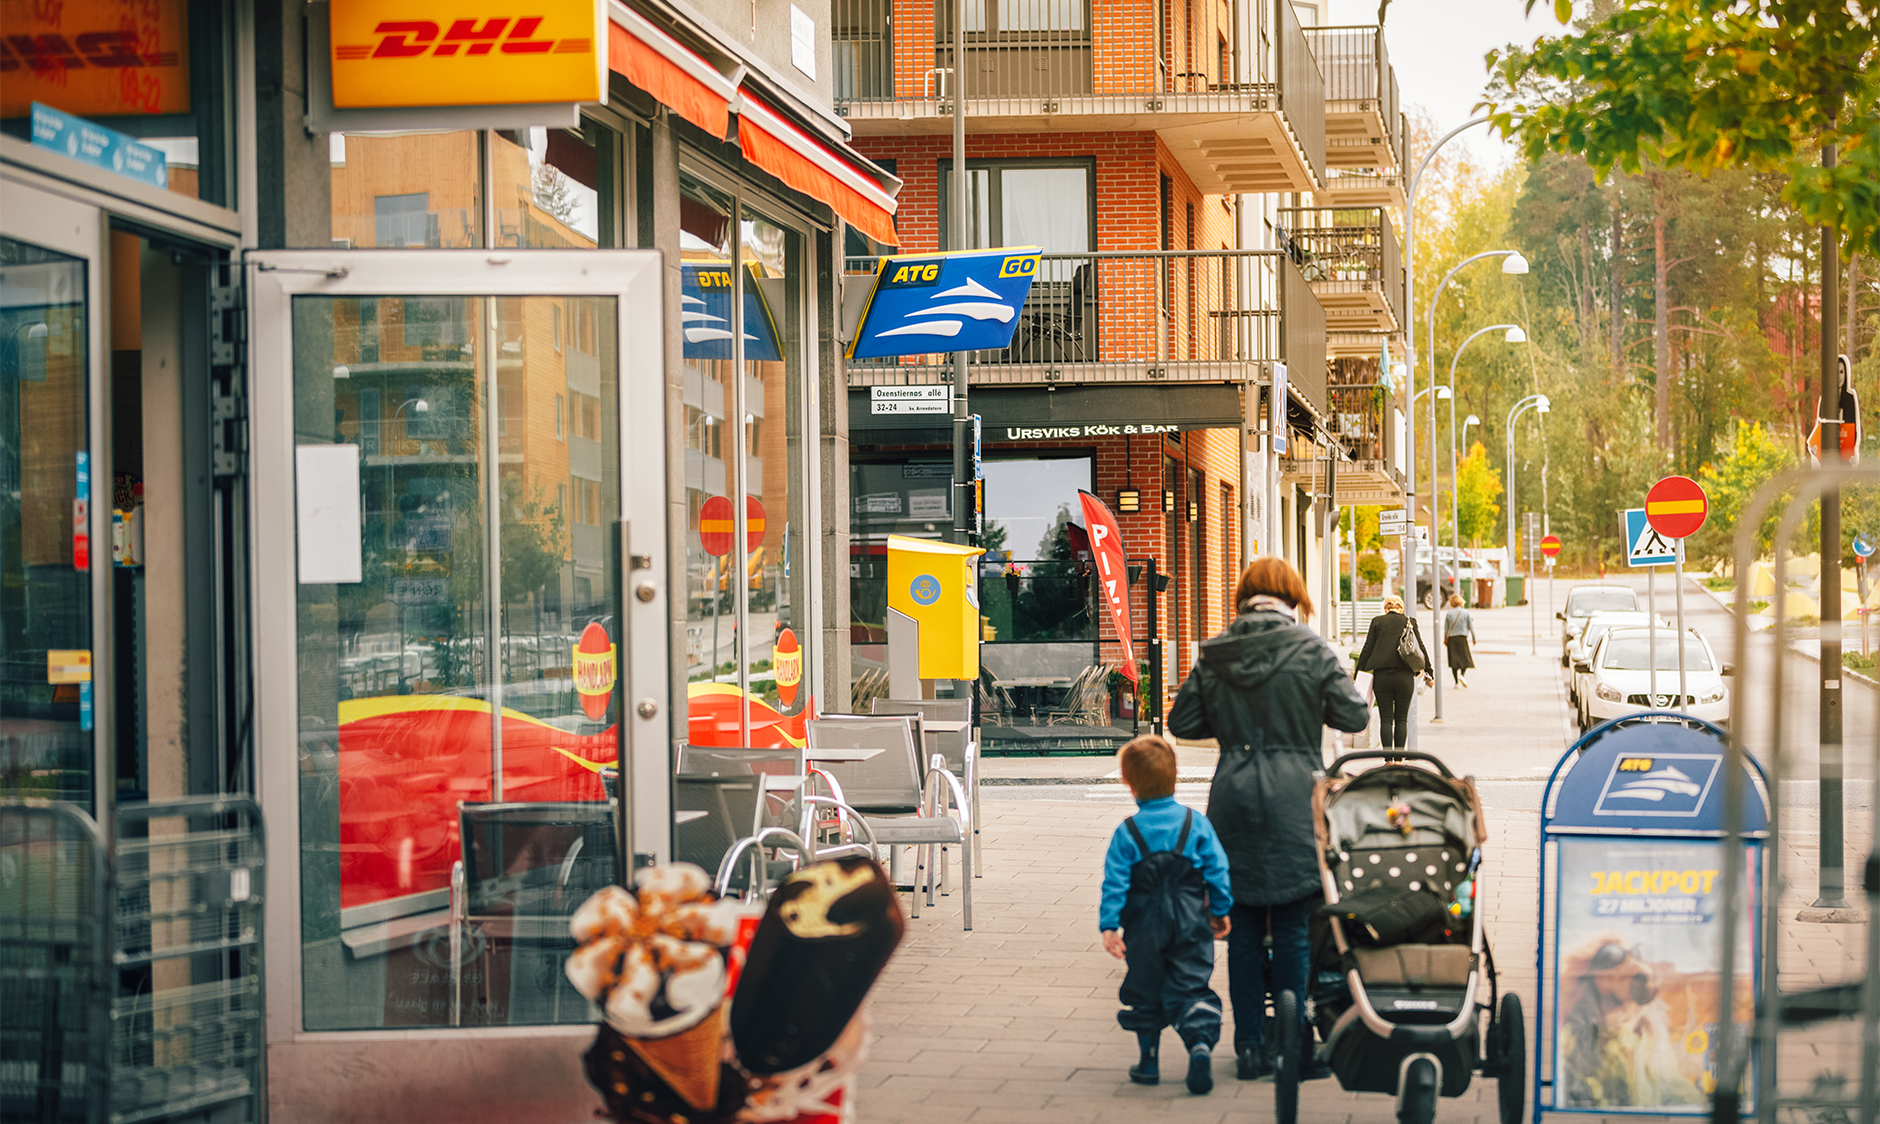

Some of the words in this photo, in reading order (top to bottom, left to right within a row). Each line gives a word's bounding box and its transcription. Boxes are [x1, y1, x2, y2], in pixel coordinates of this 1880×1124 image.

[372, 17, 555, 58] DHL
[892, 264, 939, 283] ATG
[1005, 258, 1036, 275] GO
[876, 389, 923, 398] Oxenstiernas
[927, 388, 942, 397] allé
[876, 403, 897, 412] 32-24
[1007, 427, 1080, 440] URSVIKS
[1084, 424, 1120, 436] KÖK
[1124, 424, 1138, 434] &
[1141, 424, 1179, 433] BAR
[1589, 869, 1719, 895] JACKPOT
[1598, 898, 1619, 914] 27
[1620, 897, 1697, 914] MILJONER
